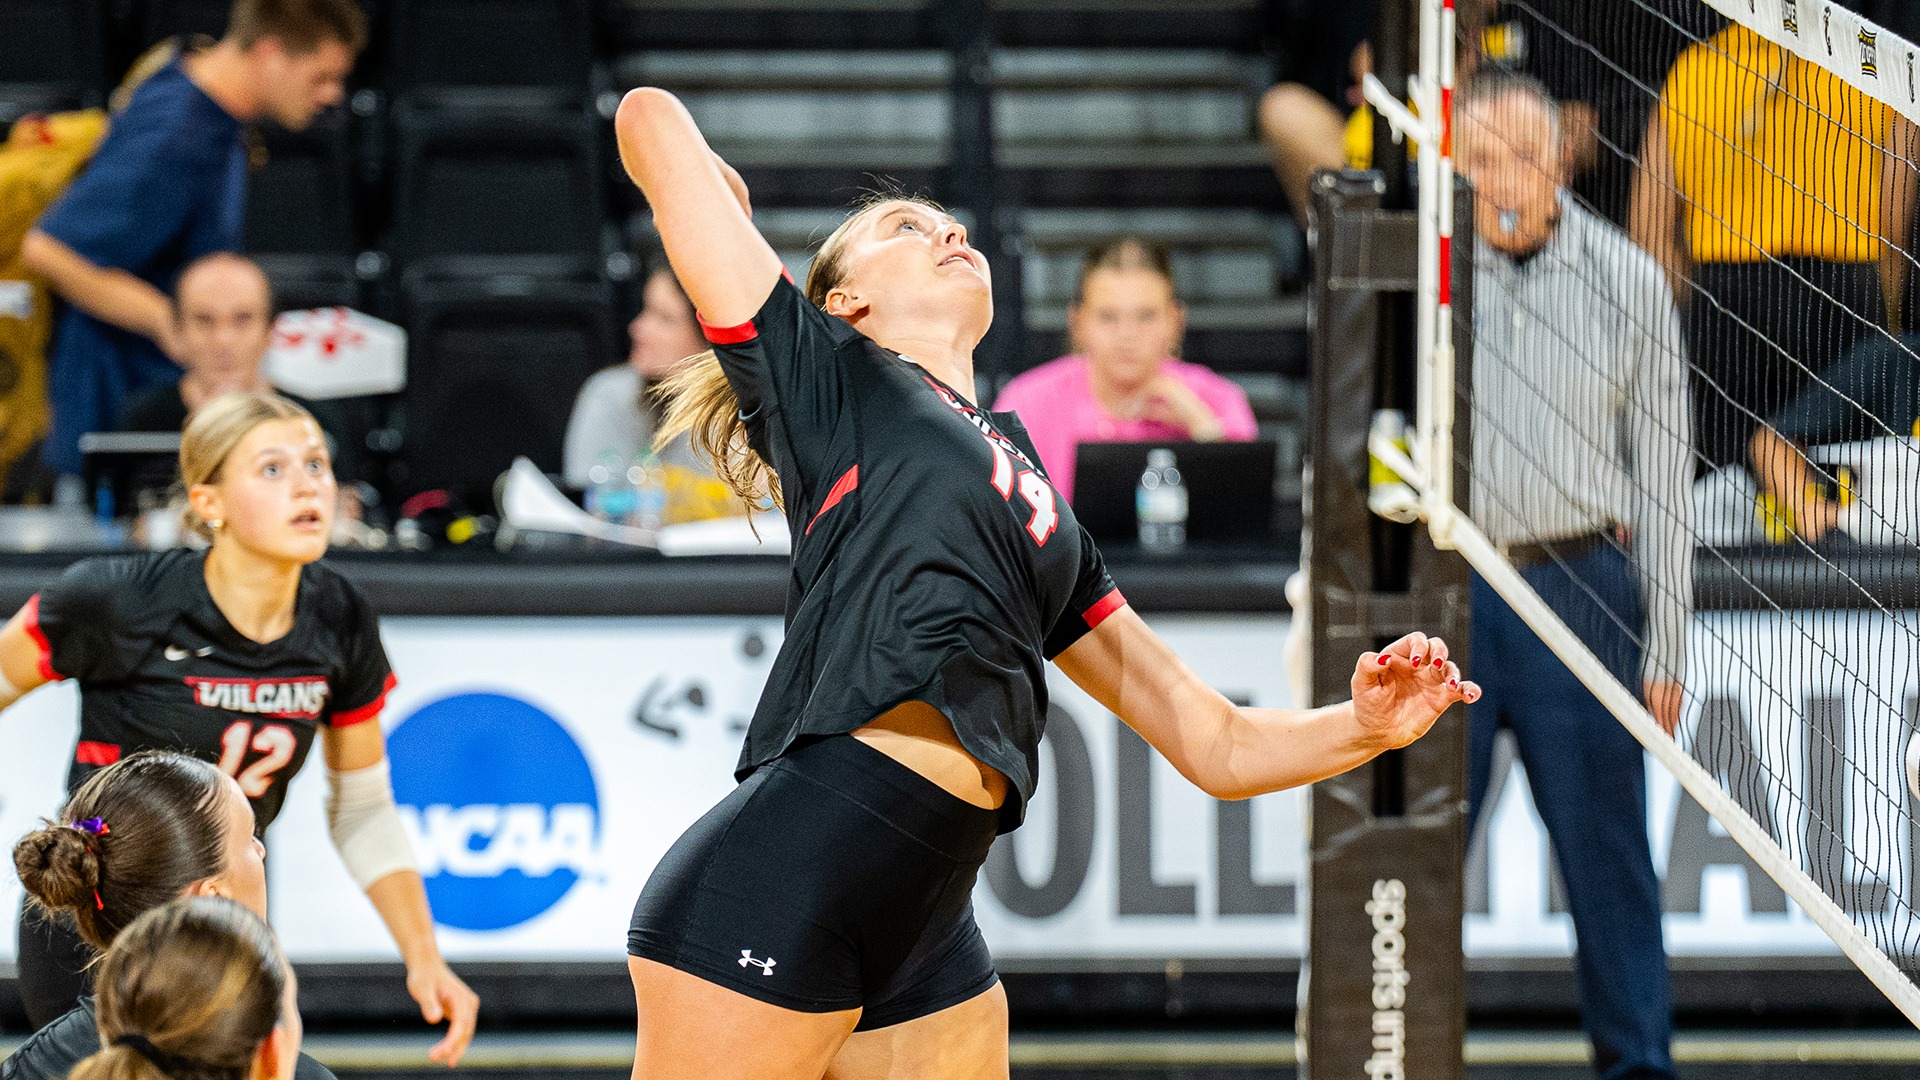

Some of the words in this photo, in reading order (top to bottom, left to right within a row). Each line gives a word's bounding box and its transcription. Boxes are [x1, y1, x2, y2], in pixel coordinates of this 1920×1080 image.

[982, 433, 1059, 547] 14
[197, 680, 329, 715] VULCANS
[220, 719, 298, 798] 12
[396, 802, 602, 878] NCAA
[1364, 879, 1411, 1010] sports
